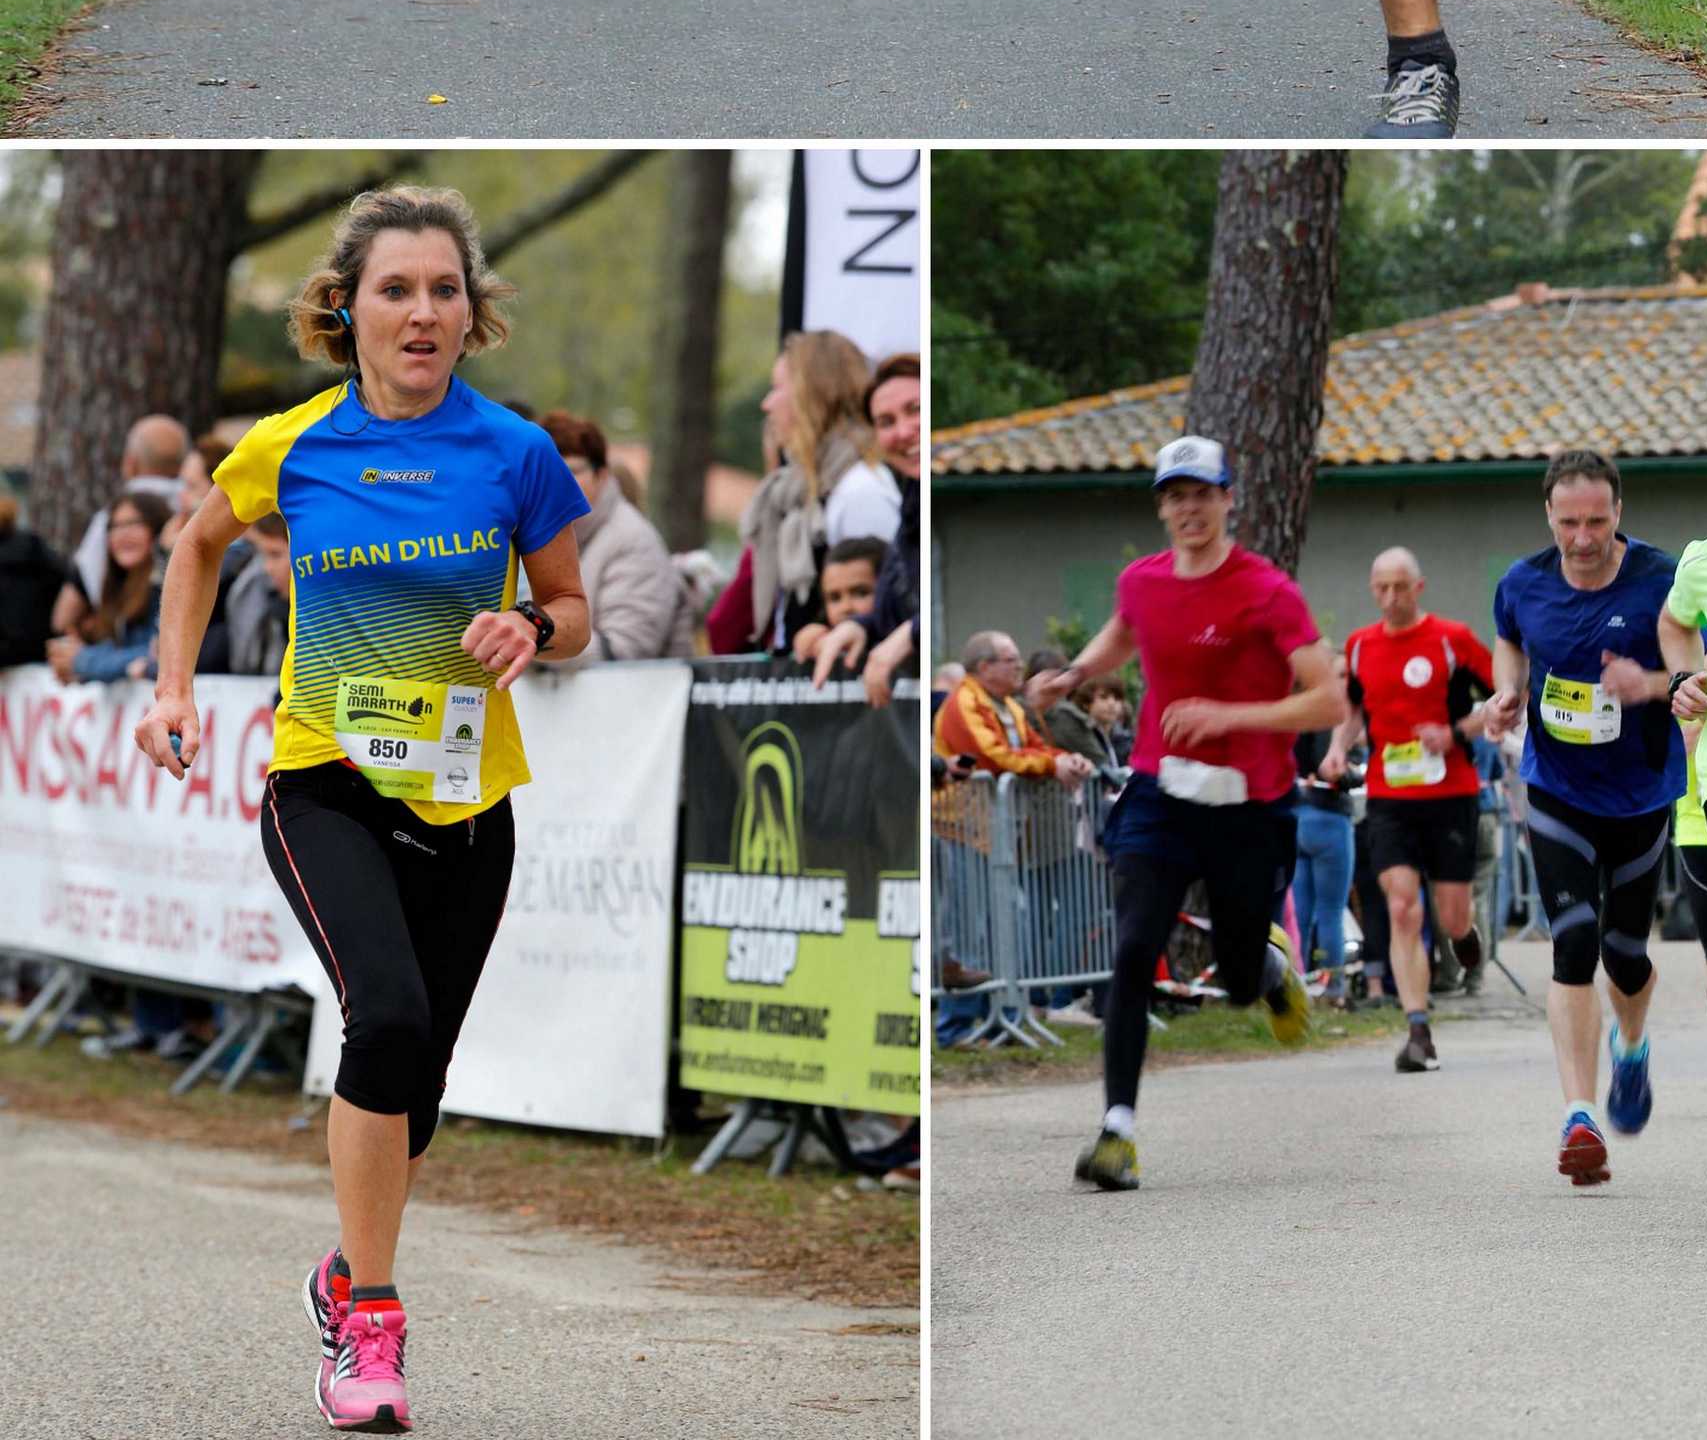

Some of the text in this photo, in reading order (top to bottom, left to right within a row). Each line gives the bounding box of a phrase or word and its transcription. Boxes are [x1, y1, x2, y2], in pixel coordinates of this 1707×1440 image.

[382, 470, 434, 482] INVERSE
[296, 527, 500, 579] ST JEAN D'ILLAC
[348, 683, 384, 697] SEMI
[451, 695, 476, 705] SUPER
[368, 738, 408, 760] 850
[684, 871, 847, 936] ENDURANCE
[726, 929, 797, 987] SHOP
